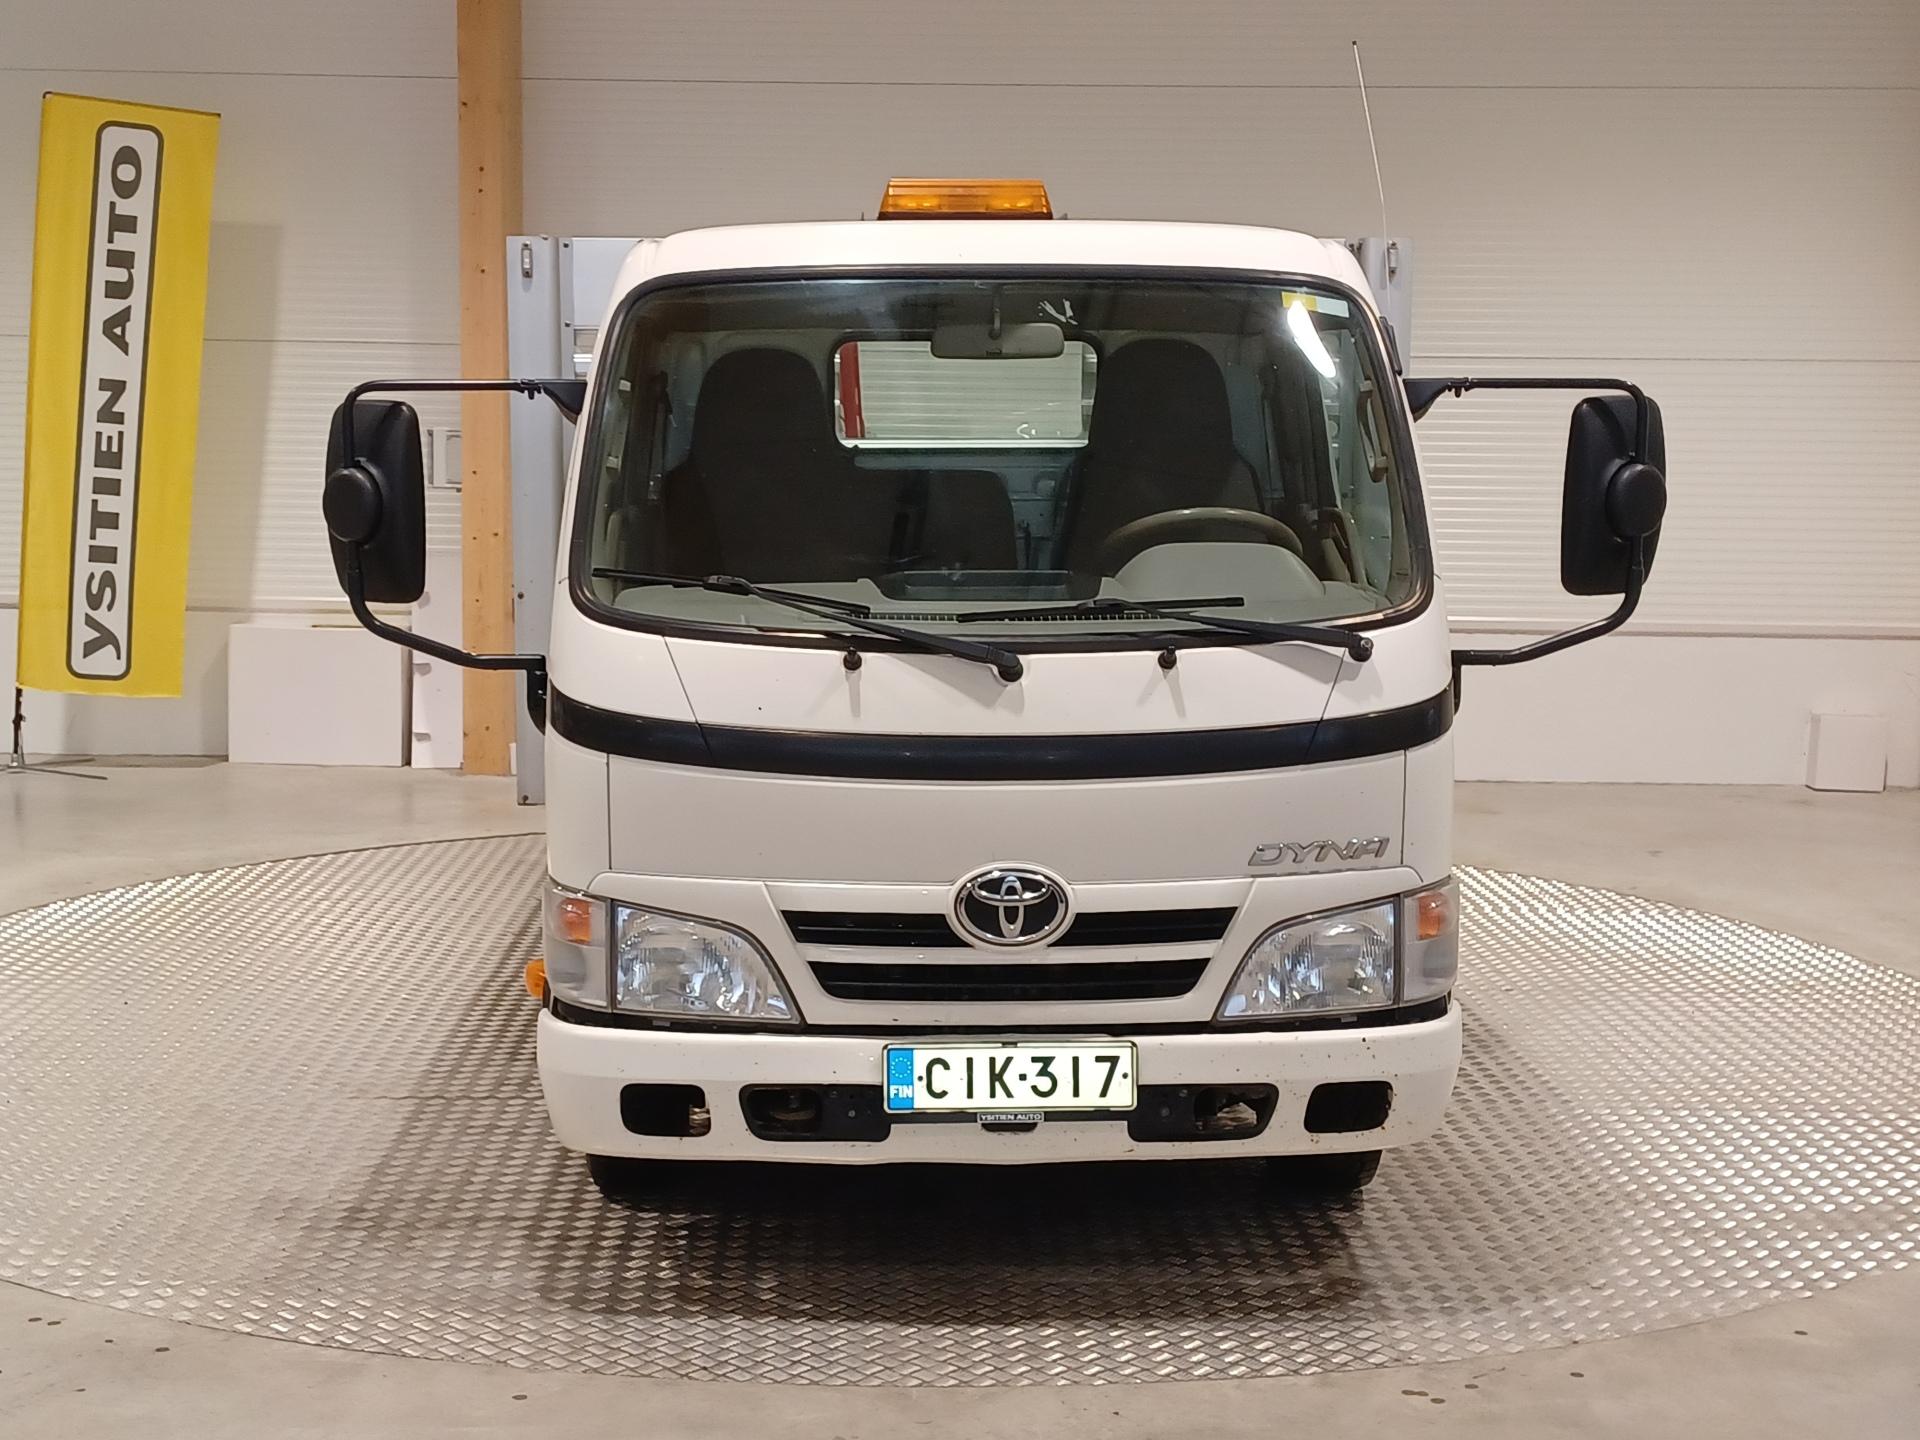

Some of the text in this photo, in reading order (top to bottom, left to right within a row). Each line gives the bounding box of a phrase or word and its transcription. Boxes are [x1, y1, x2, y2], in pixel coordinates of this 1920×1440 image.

[82, 144, 143, 661] YSITIEN AUTO
[1247, 836, 1390, 867] DYNA
[890, 1084, 913, 1099] FIN
[980, 1113, 1042, 1121] YSITIEN AUTO
